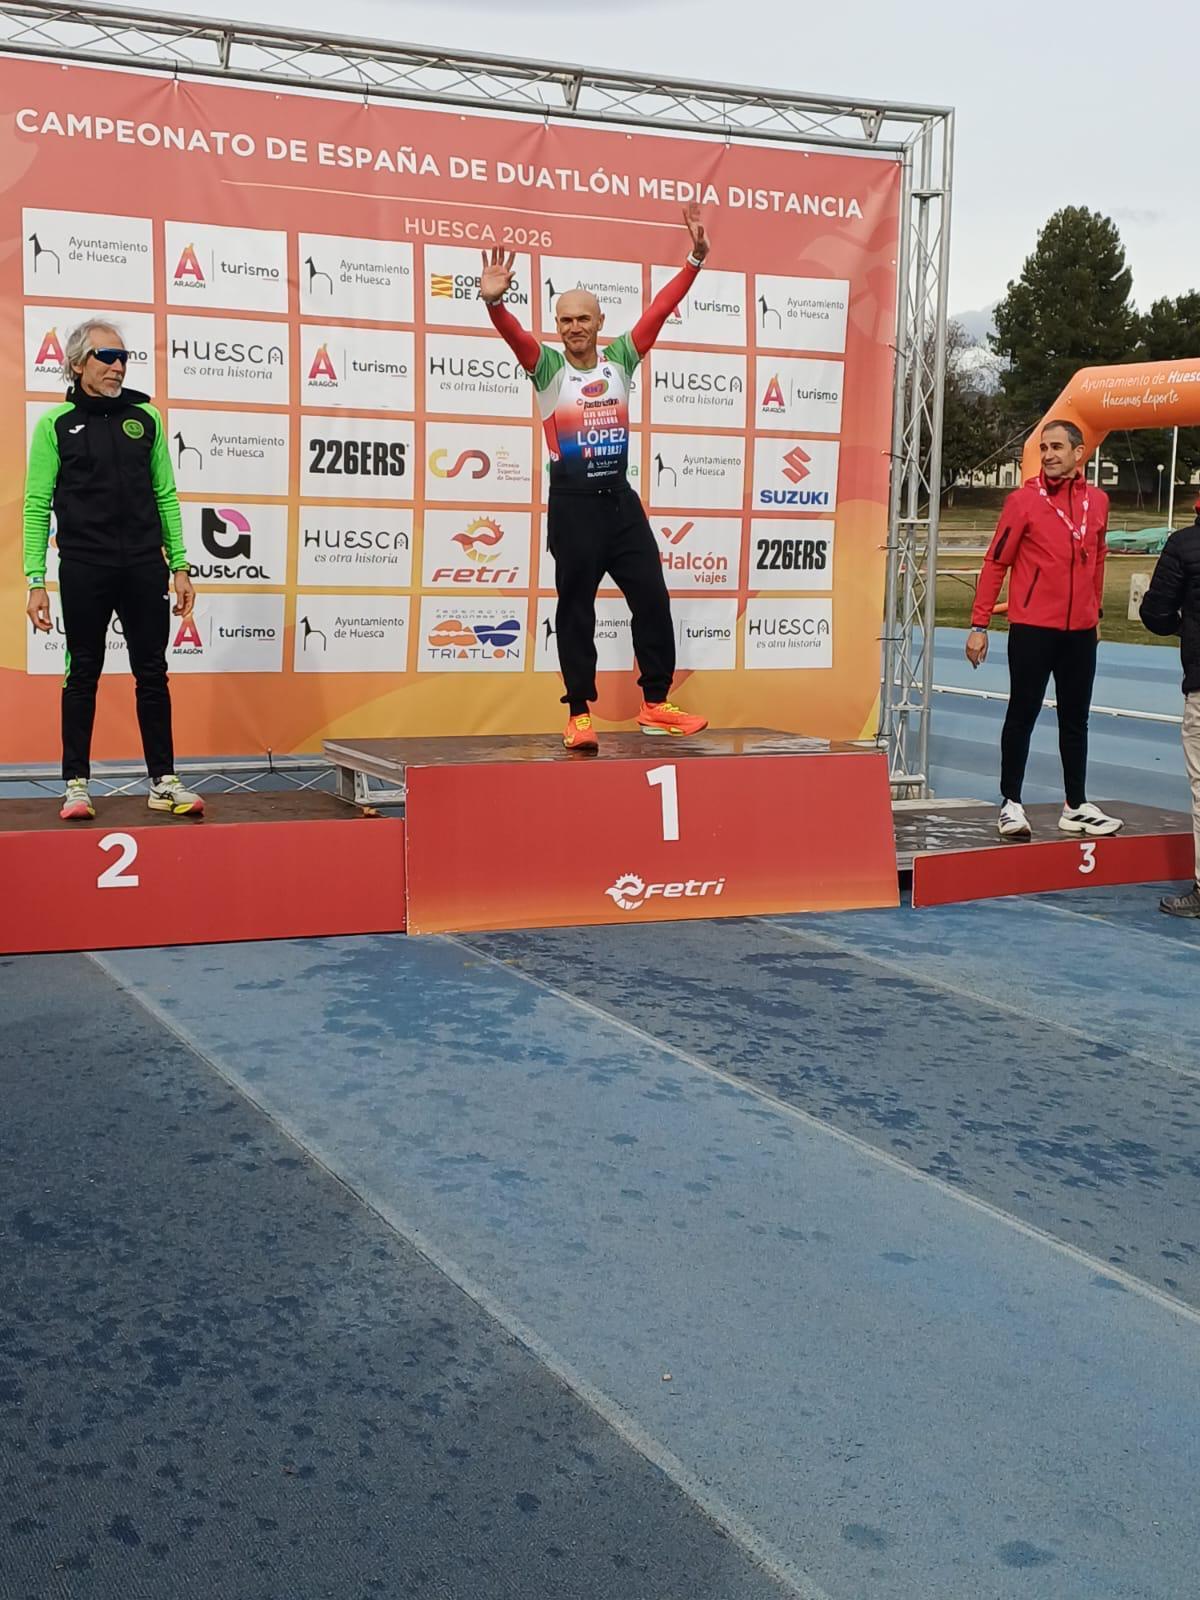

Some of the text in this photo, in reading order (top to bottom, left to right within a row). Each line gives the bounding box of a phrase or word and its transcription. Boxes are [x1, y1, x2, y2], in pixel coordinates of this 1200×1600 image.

[15, 109, 864, 219] CAMPEONATO DE ESPAÑA DE DUATLÓN MEDIA DISTANCIA
[405, 217, 553, 248] HUESCA 2026
[69, 236, 148, 253] Ayuntamiento
[69, 251, 127, 264] de Huesca
[221, 261, 279, 279] turismo
[340, 260, 410, 275] Ayuntamiento
[340, 273, 391, 286] de Huesca
[455, 288, 471, 300] DE
[694, 300, 740, 313] turismo
[787, 297, 844, 310] Ayuntamiento
[787, 309, 830, 321] de Huesca
[172, 340, 284, 365] HUESCA
[184, 366, 272, 380] es otra historia
[352, 360, 407, 374] turismo
[440, 380, 519, 394] es otra historia
[655, 371, 742, 393] HUESCA
[1081, 375, 1150, 392] Ayuntamiento
[1152, 373, 1165, 385] de
[664, 394, 734, 406] es otra historia
[797, 388, 838, 401] turismo
[1103, 388, 1179, 412] Hacemos deporte
[211, 434, 285, 447] Ayuntamiento
[577, 427, 626, 446] LÓPEZ
[211, 447, 265, 458] de Huesca
[309, 439, 406, 477] 226ERS
[683, 454, 741, 466] Ayuntamiento
[683, 466, 725, 477] de Huesca
[760, 489, 829, 505] SUZUKI
[304, 529, 409, 550] HUESCA
[315, 552, 398, 565] es otra historia
[660, 552, 728, 570] Halcón
[757, 539, 827, 570] 226ERS
[694, 572, 727, 584] viajes
[334, 616, 405, 627] Ayuntamiento
[749, 618, 830, 636] HUESCA
[219, 626, 276, 638] turismo
[334, 628, 385, 639] de Huesca
[686, 626, 731, 639] turismo
[756, 637, 821, 649] es otra historia
[646, 764, 679, 841] 1
[97, 832, 139, 888] 2
[1078, 842, 1097, 874] 3
